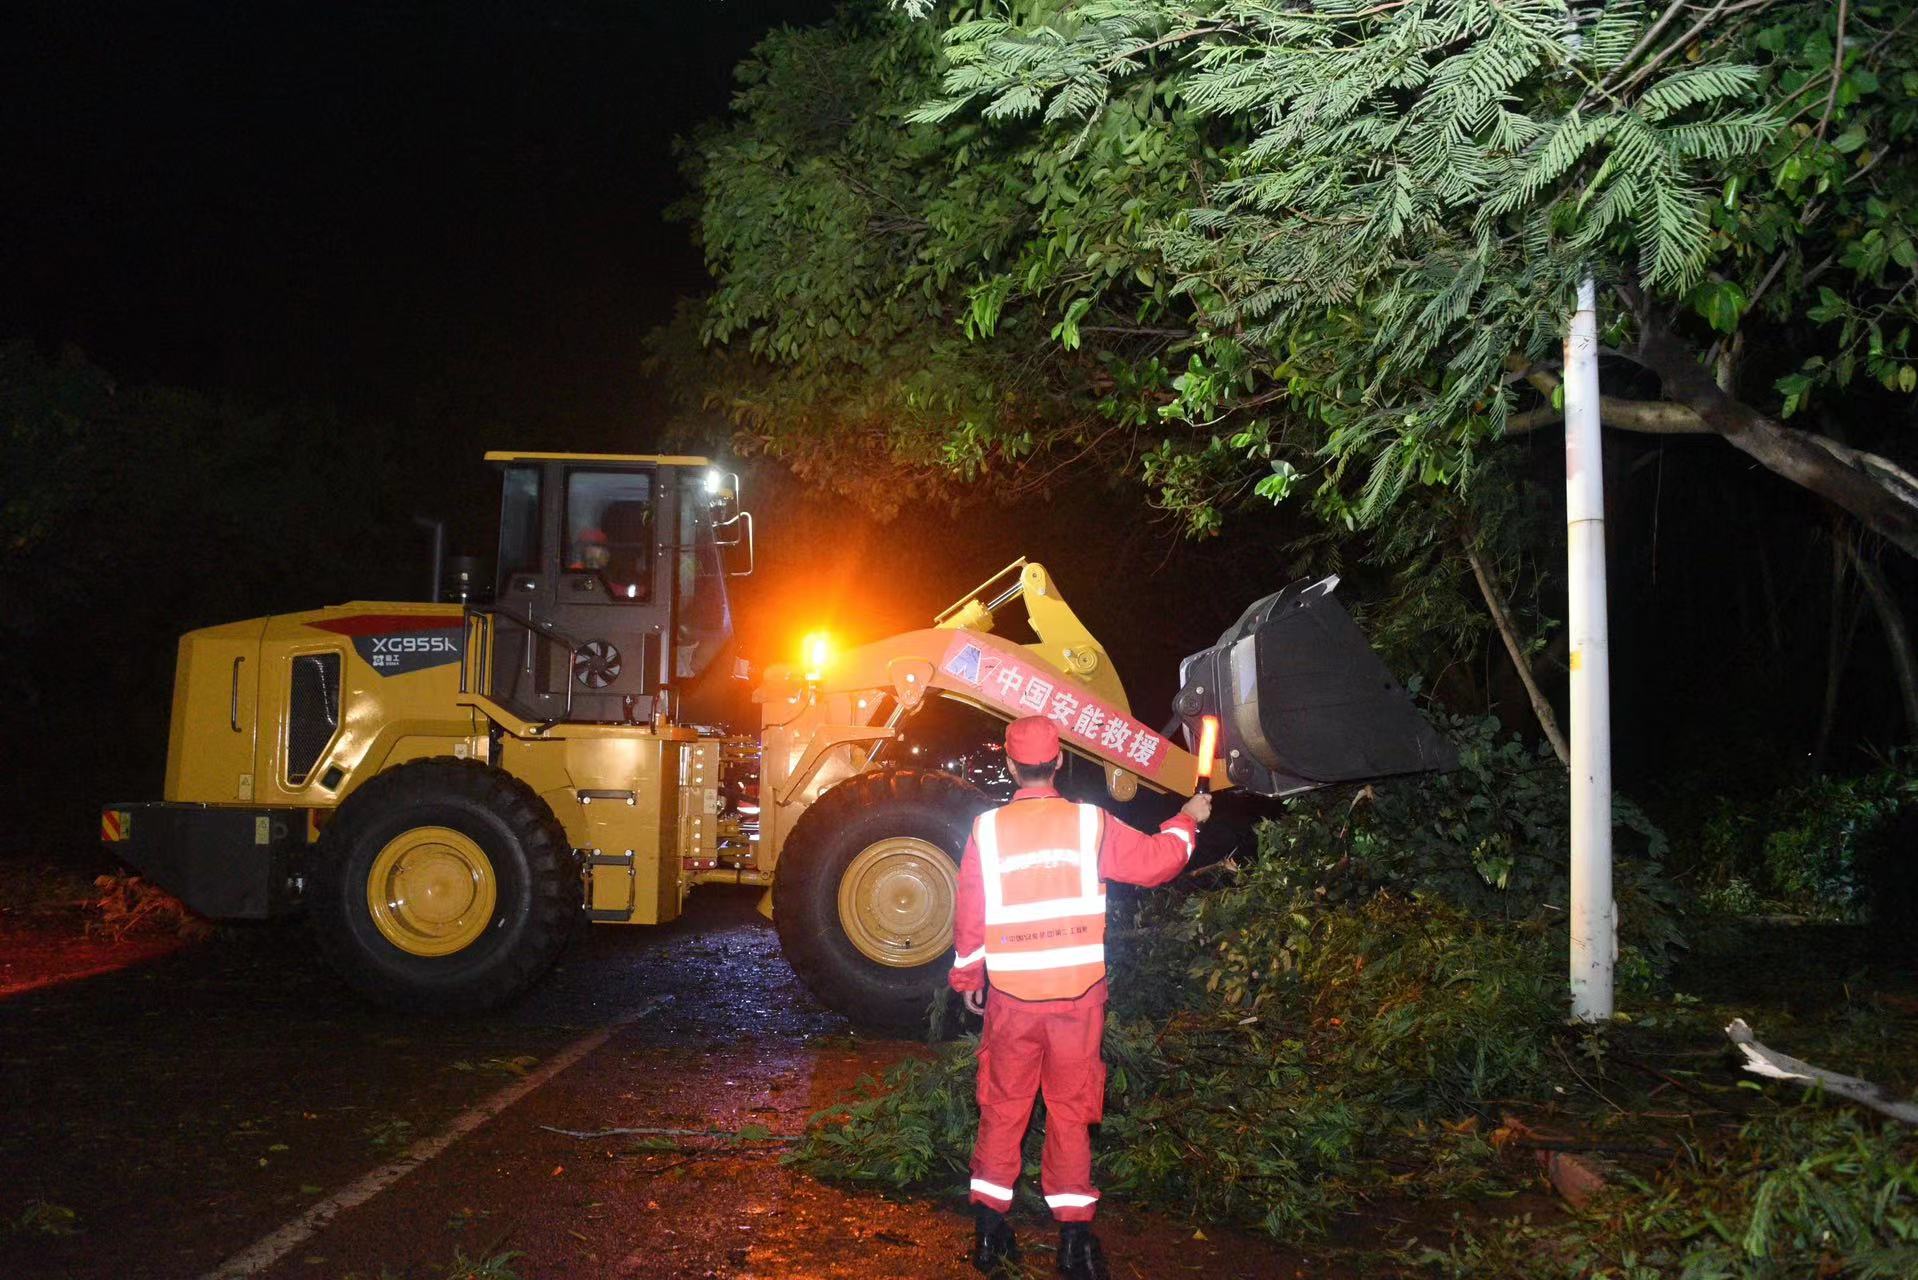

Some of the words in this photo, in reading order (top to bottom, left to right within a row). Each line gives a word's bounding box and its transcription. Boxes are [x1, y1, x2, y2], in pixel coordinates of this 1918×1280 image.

[996, 666, 1160, 767] 中国安能救援
